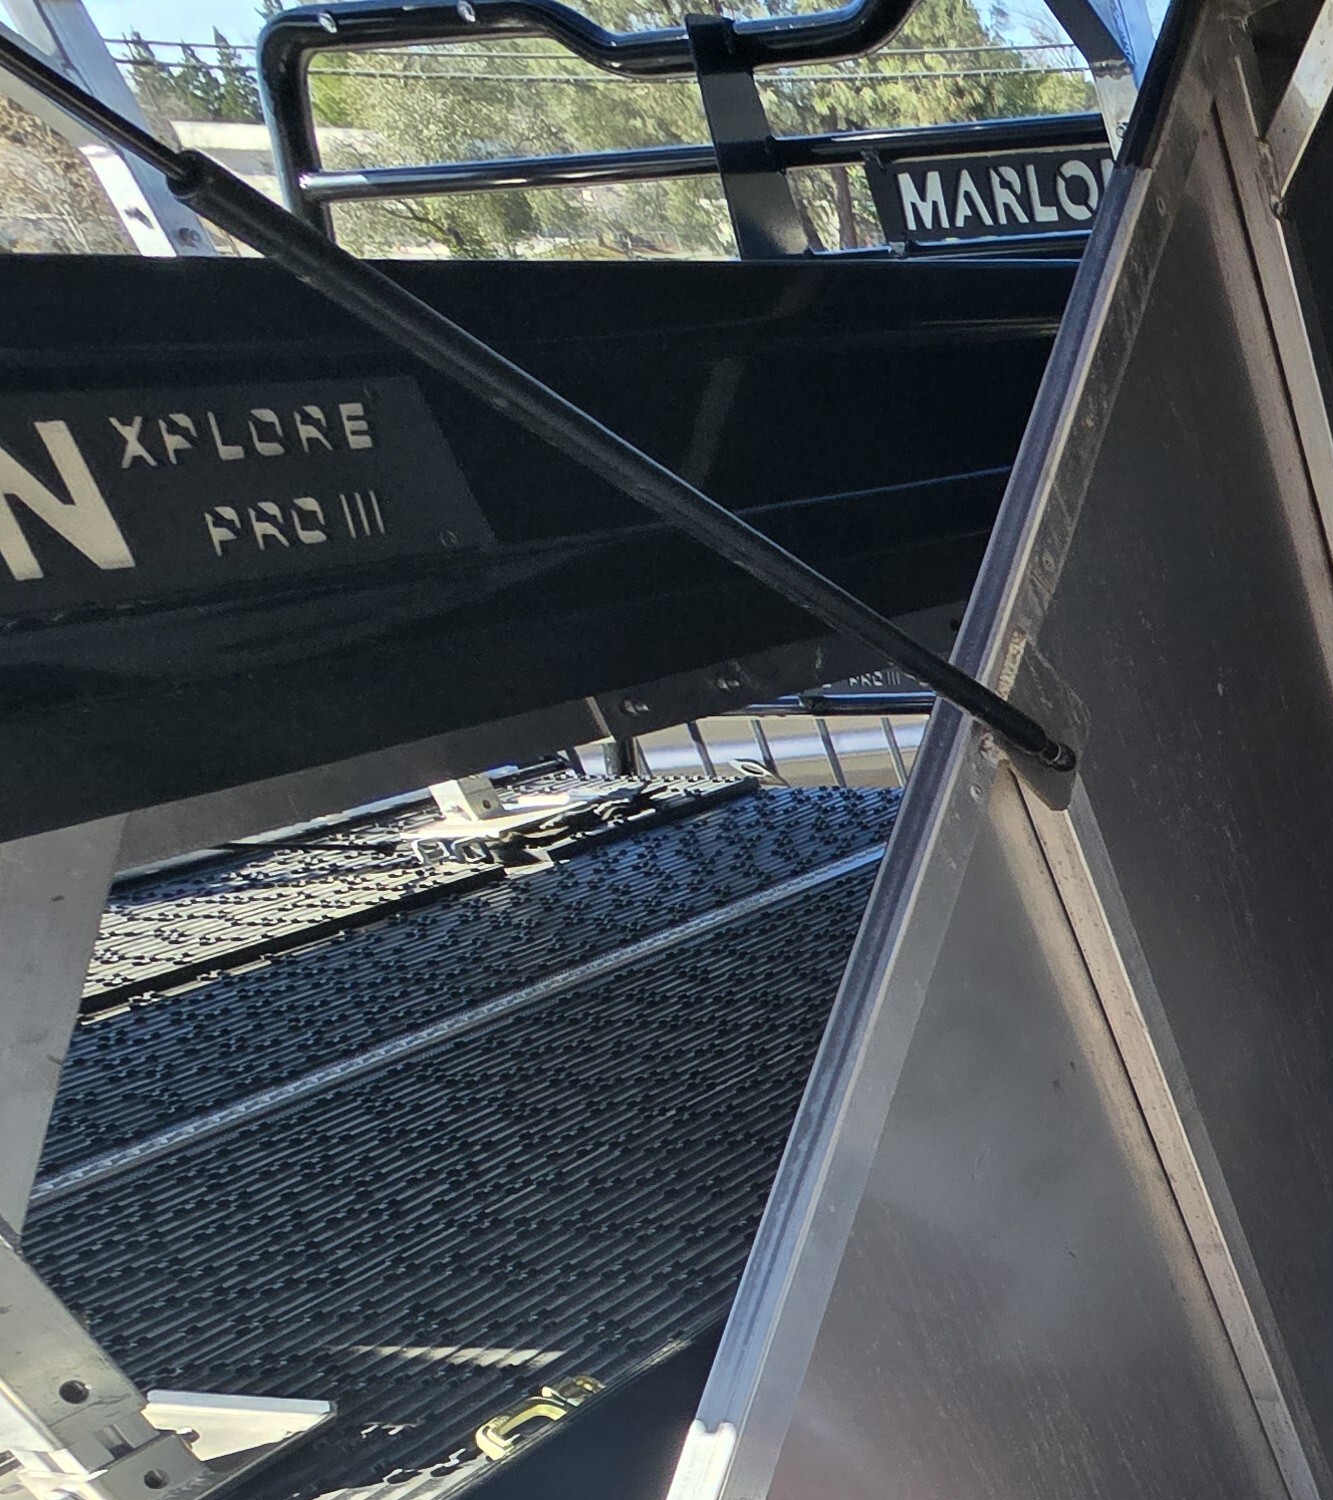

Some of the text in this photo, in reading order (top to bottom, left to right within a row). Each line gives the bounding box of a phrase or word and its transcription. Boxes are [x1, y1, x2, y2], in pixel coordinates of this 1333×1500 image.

[897, 158, 1114, 232] MARLO
[107, 402, 375, 470] XPLORE
[204, 496, 328, 557] PRO
